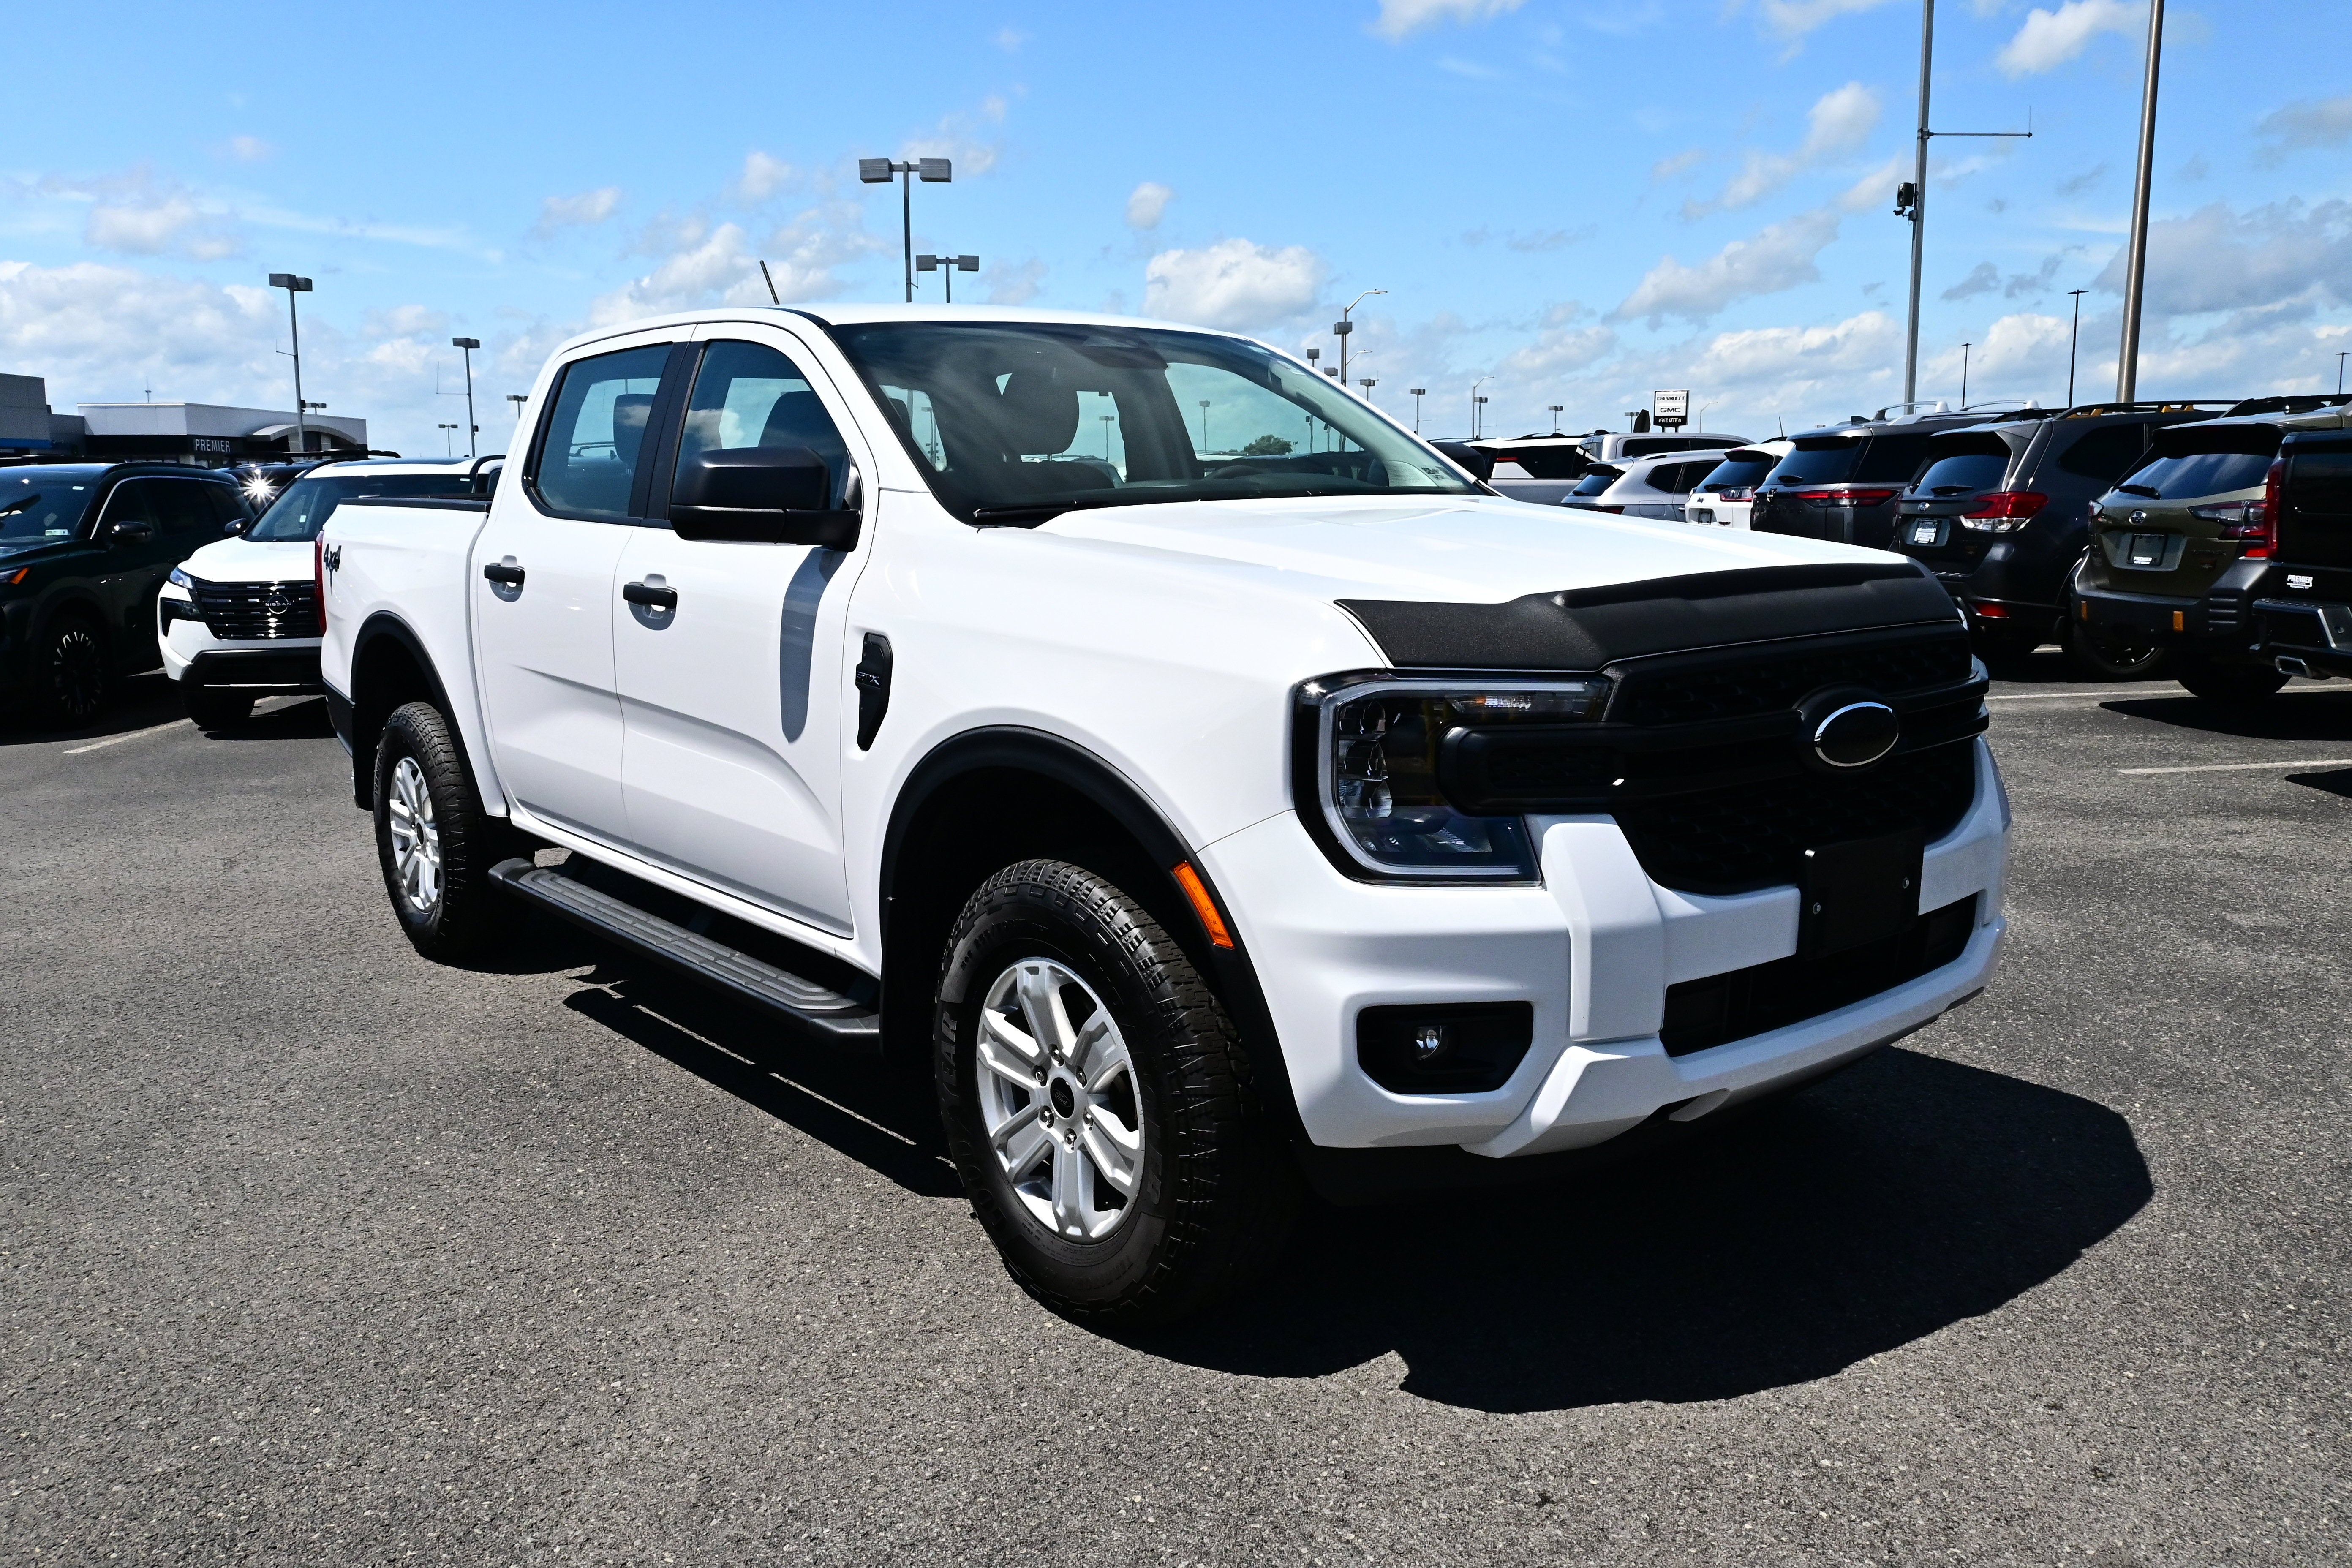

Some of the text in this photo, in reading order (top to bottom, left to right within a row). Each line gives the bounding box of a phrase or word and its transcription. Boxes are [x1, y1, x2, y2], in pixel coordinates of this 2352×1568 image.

[195, 438, 230, 452] PREMIER
[323, 543, 342, 572] 4x4
[2287, 575, 2313, 583] PREMIER
[1054, 1091, 1068, 1105] Ford
